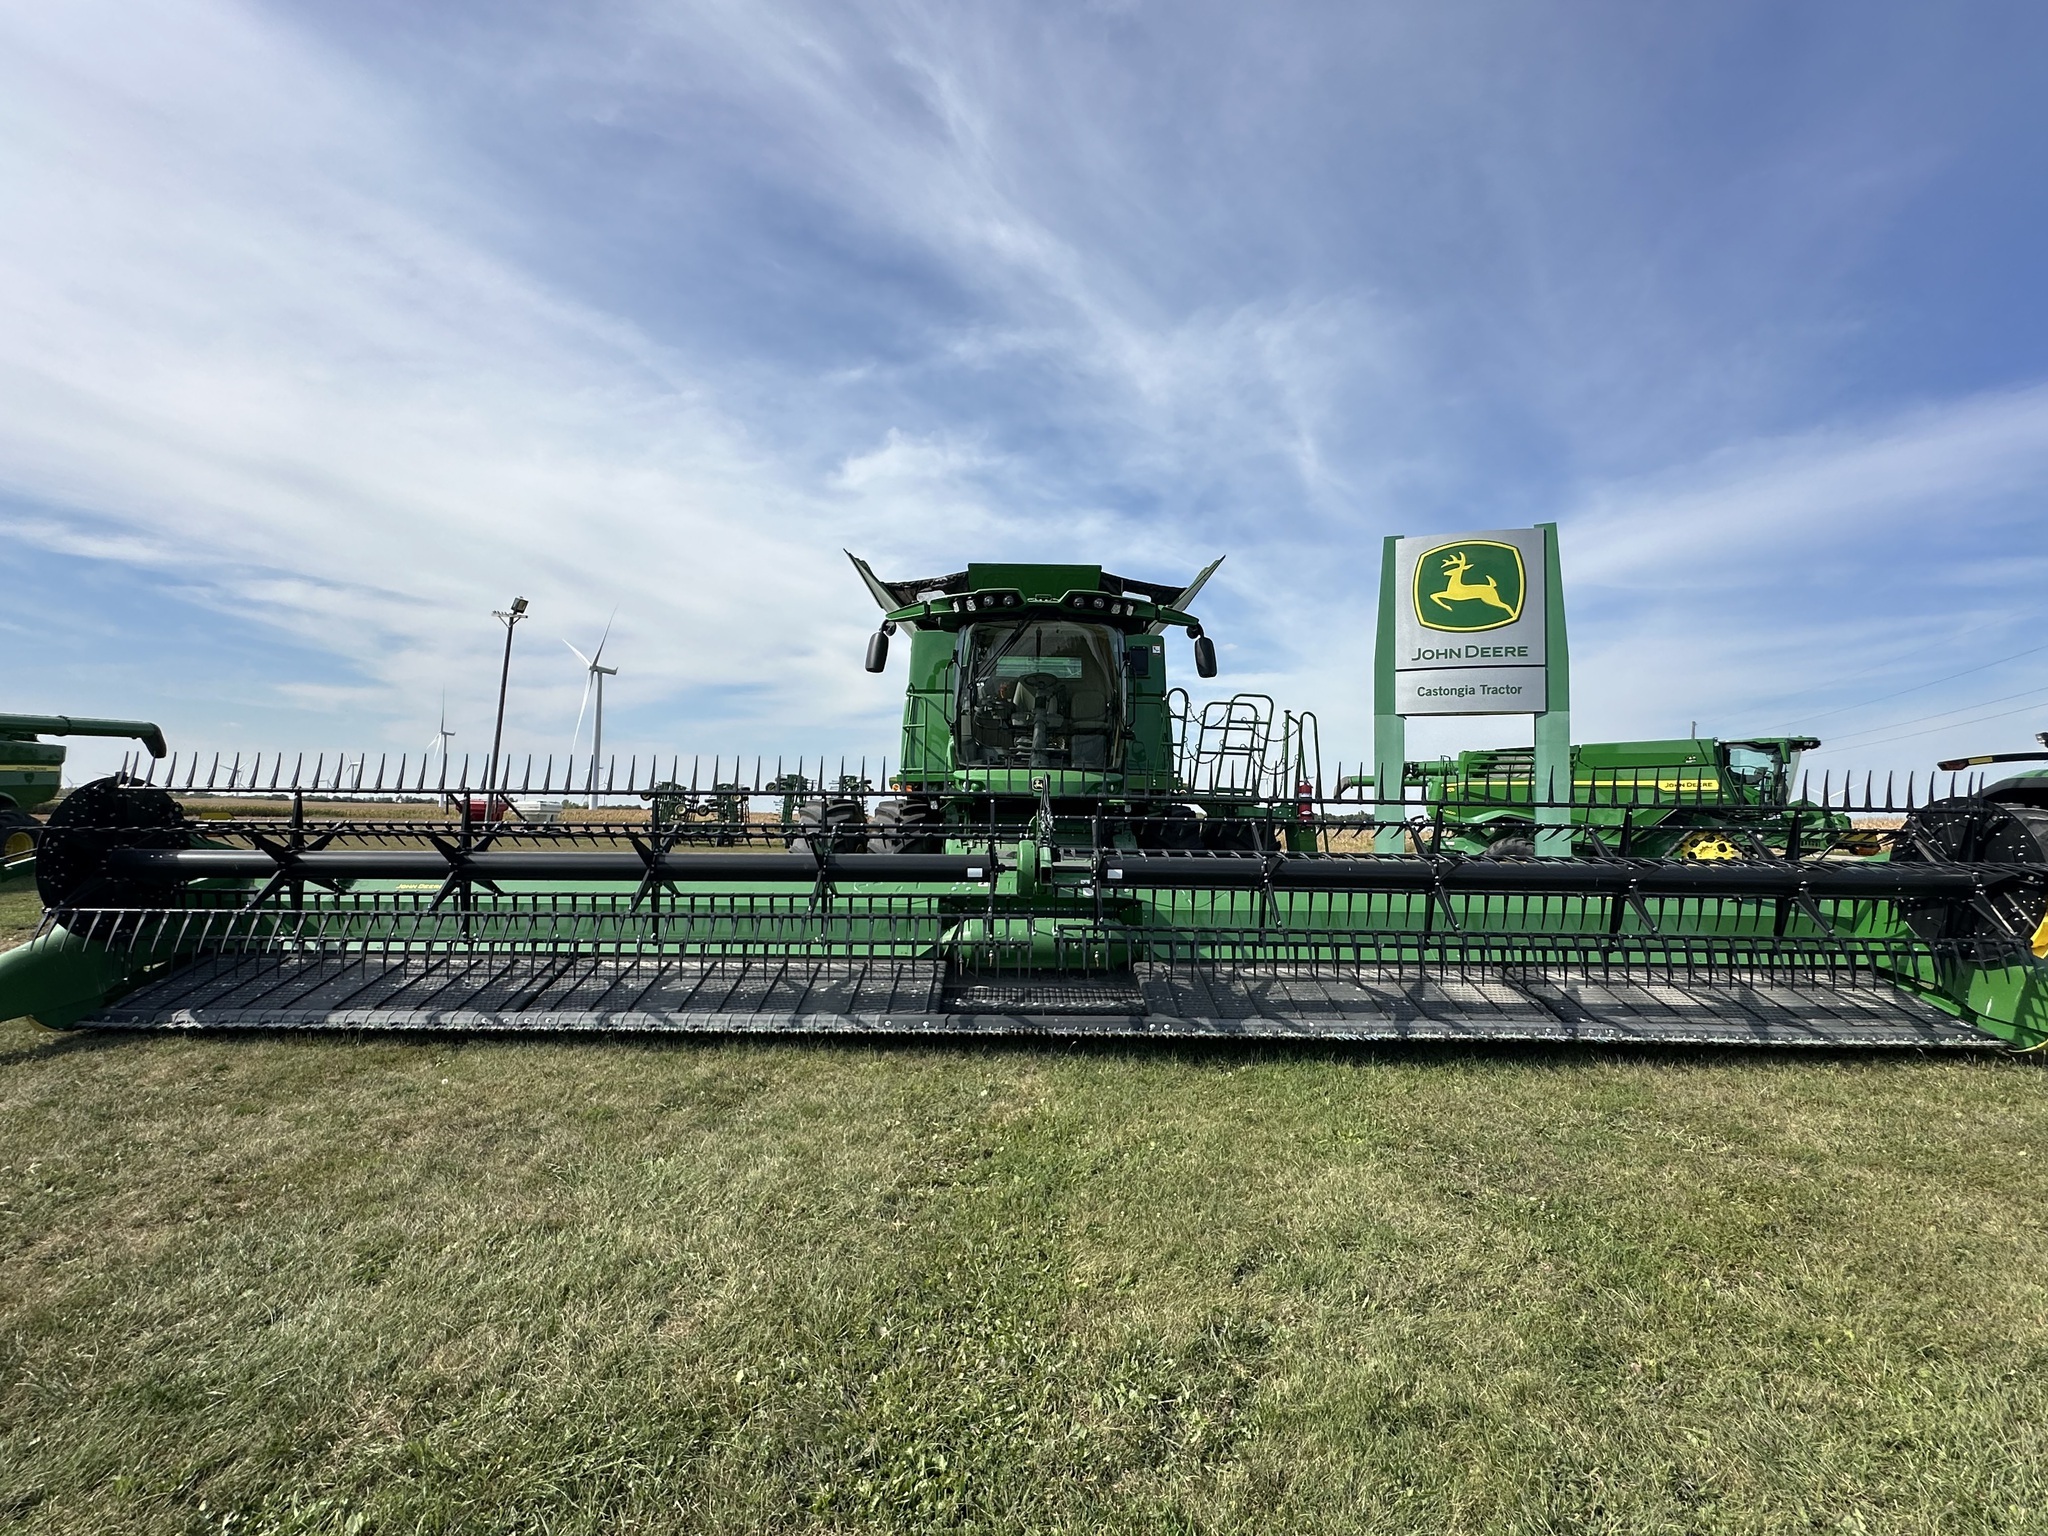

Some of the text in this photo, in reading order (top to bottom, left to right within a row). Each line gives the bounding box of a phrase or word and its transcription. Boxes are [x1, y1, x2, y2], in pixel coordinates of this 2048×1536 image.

[1412, 645, 1528, 661] JOHN DEERE
[1417, 684, 1522, 697] Castongia Tractor
